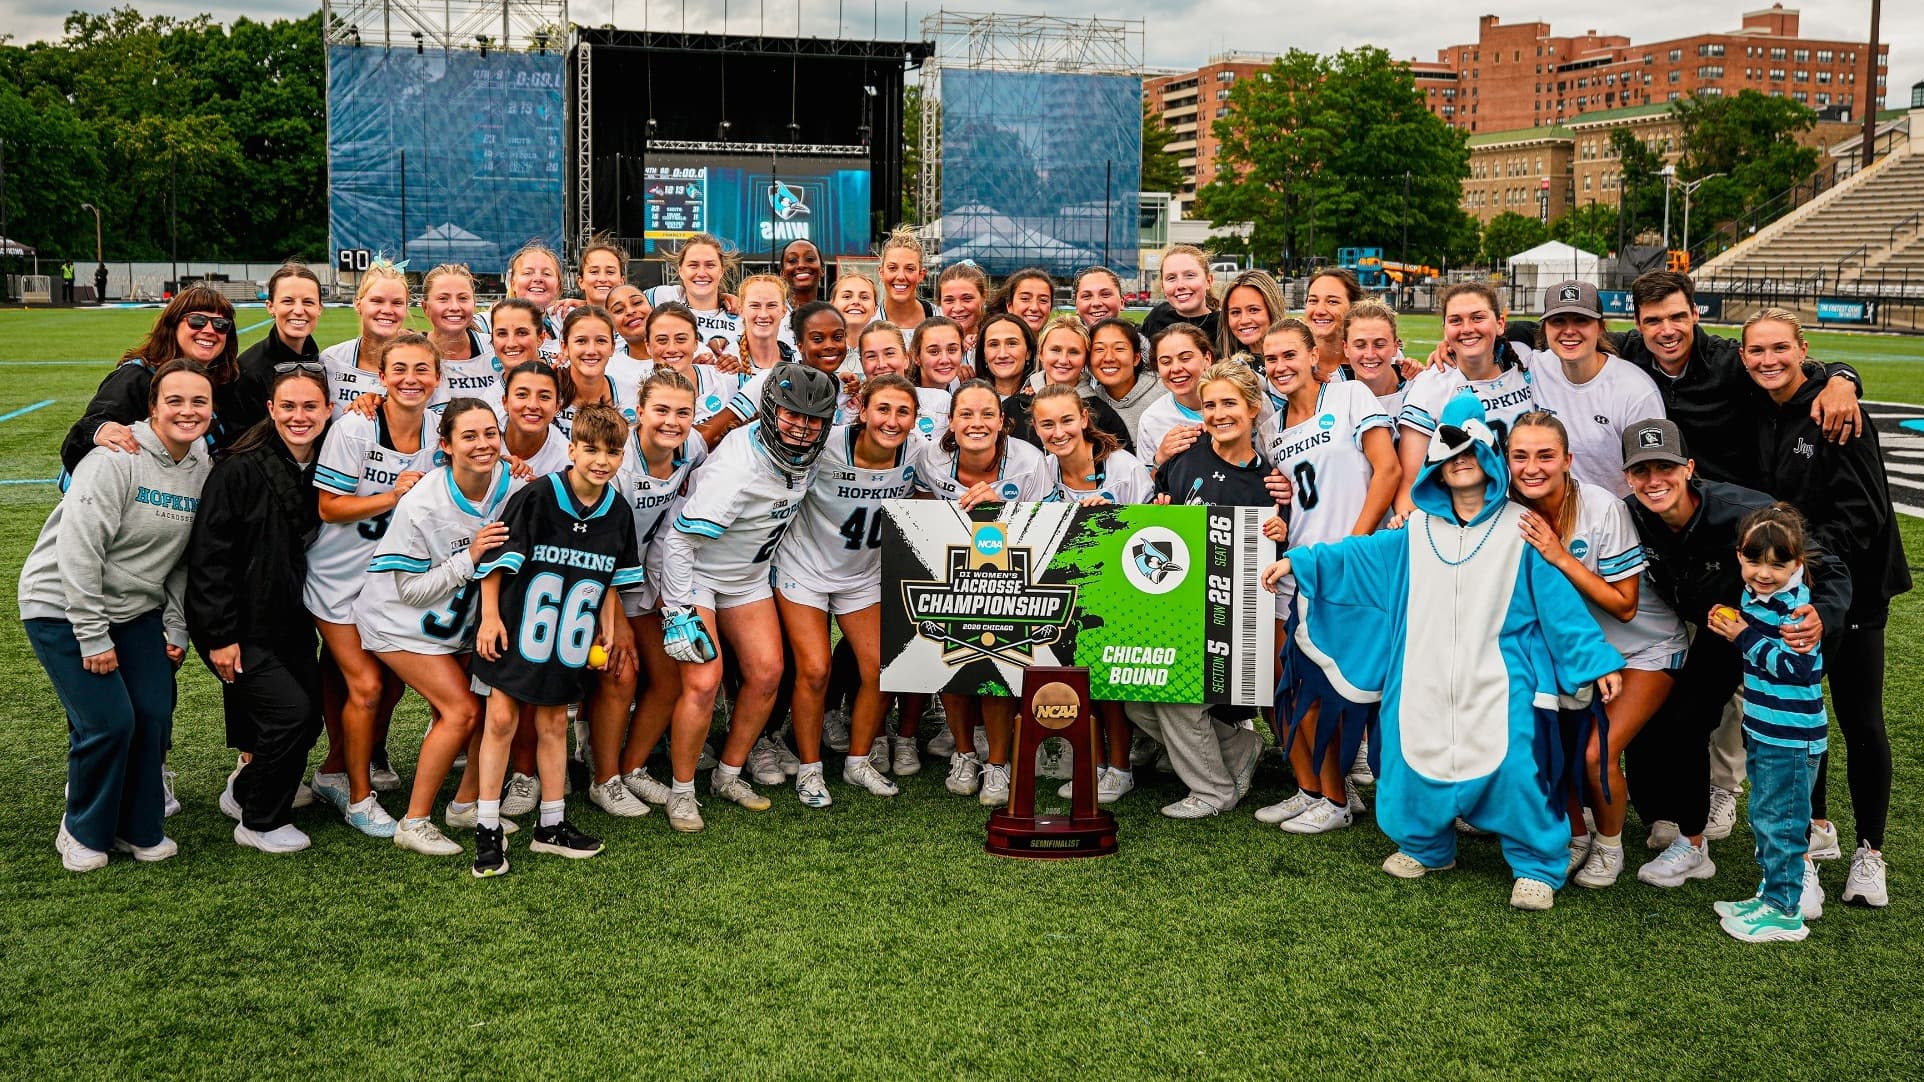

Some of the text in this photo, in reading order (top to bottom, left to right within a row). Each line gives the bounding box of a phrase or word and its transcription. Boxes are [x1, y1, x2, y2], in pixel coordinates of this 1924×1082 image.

[672, 168, 704, 178] 0:00.0
[340, 250, 370, 271] 90
[697, 316, 736, 332] PKINS
[447, 375, 494, 389] PKINS
[1480, 386, 1532, 412] OPKINS
[135, 486, 202, 513] HOPKIN
[837, 485, 906, 499] HOPKINS
[977, 539, 1003, 549] NCAA
[531, 544, 617, 573] HOPKINS
[973, 571, 1019, 579] WOMEN'S
[953, 578, 1024, 594] LACROSSE
[917, 593, 1061, 617] CHAMPIONSHIP
[1207, 515, 1232, 693] SECTION 5 ROW 22 SEAT 26
[518, 571, 606, 669] 66
[982, 624, 1014, 632] CHICAGO
[1102, 645, 1177, 665] CHICAGO
[1108, 666, 1169, 686] BOUND
[1037, 704, 1079, 719] NCAA
[1030, 839, 1081, 849] SEMIFINALIST
